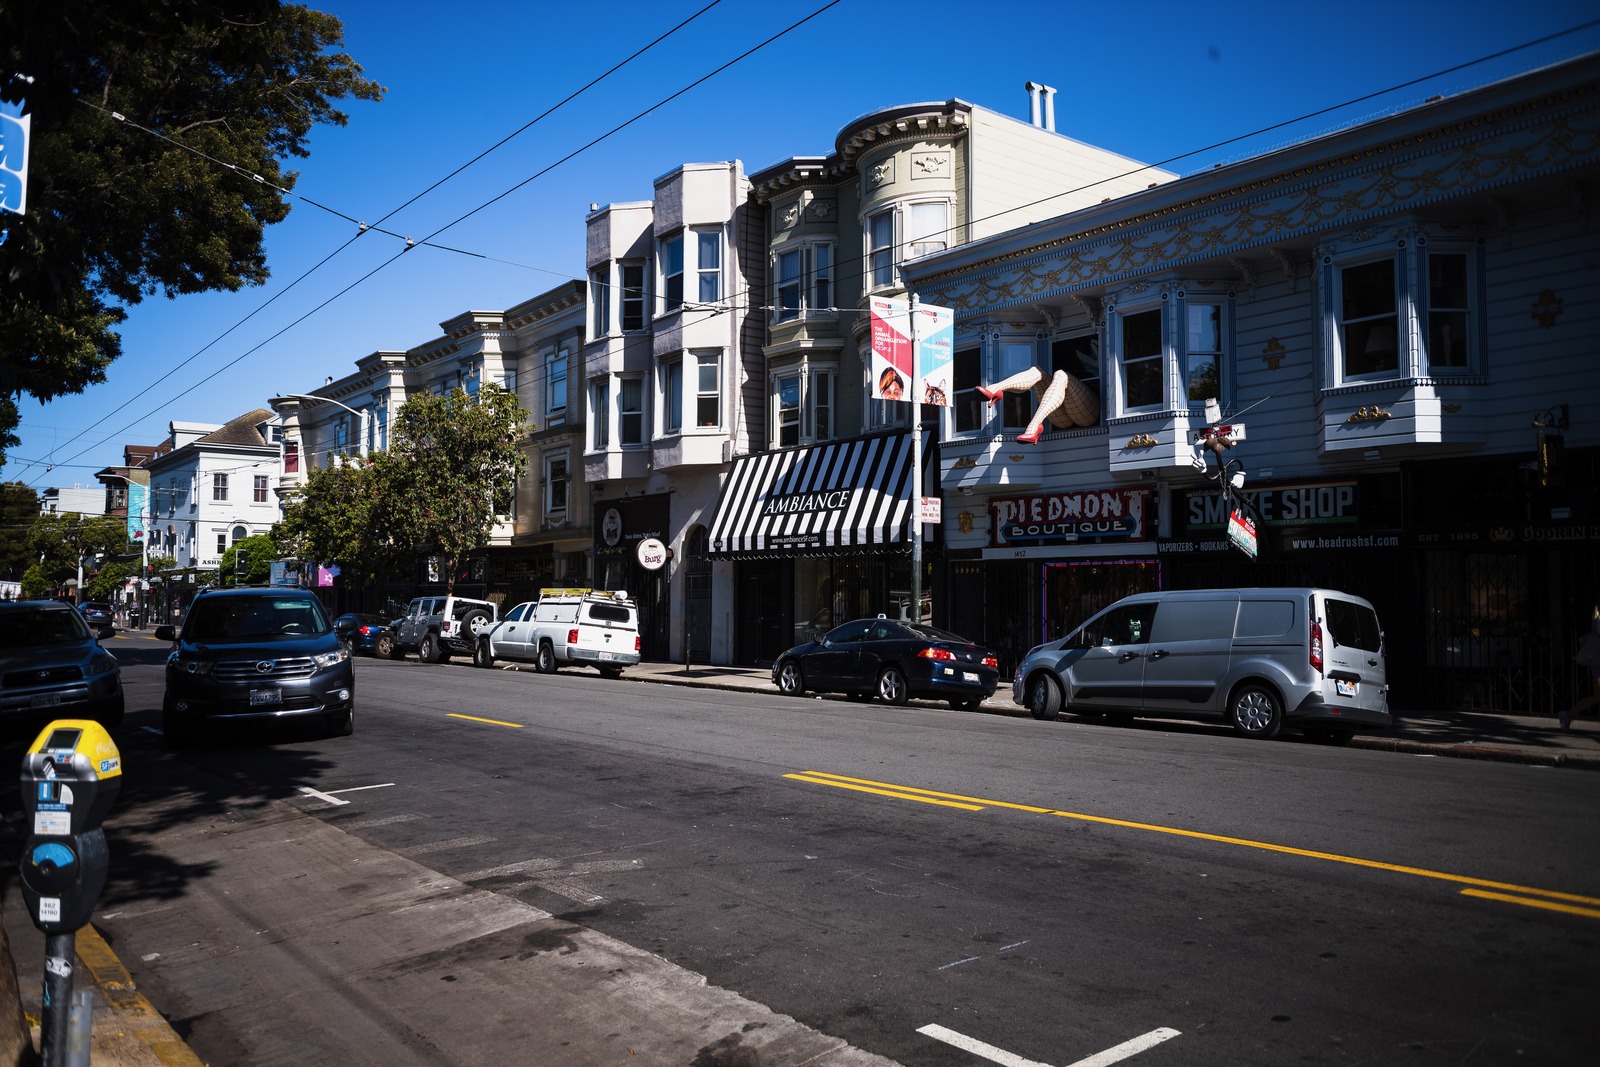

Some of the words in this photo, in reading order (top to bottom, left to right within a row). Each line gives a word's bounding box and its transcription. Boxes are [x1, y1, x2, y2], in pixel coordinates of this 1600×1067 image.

[1193, 429, 1240, 442] ASBRY
[763, 490, 850, 515] AMBIANCE
[1281, 486, 1354, 520] SHOP
[991, 489, 1150, 545] PIEDMONT
[1011, 521, 1127, 536] BOUTIQUE
[1450, 532, 1478, 541] 1895
[1158, 542, 1194, 552] VAPORIZERS
[1200, 541, 1229, 551] HOOKAHS
[1292, 535, 1399, 550] www.headrushsf.com
